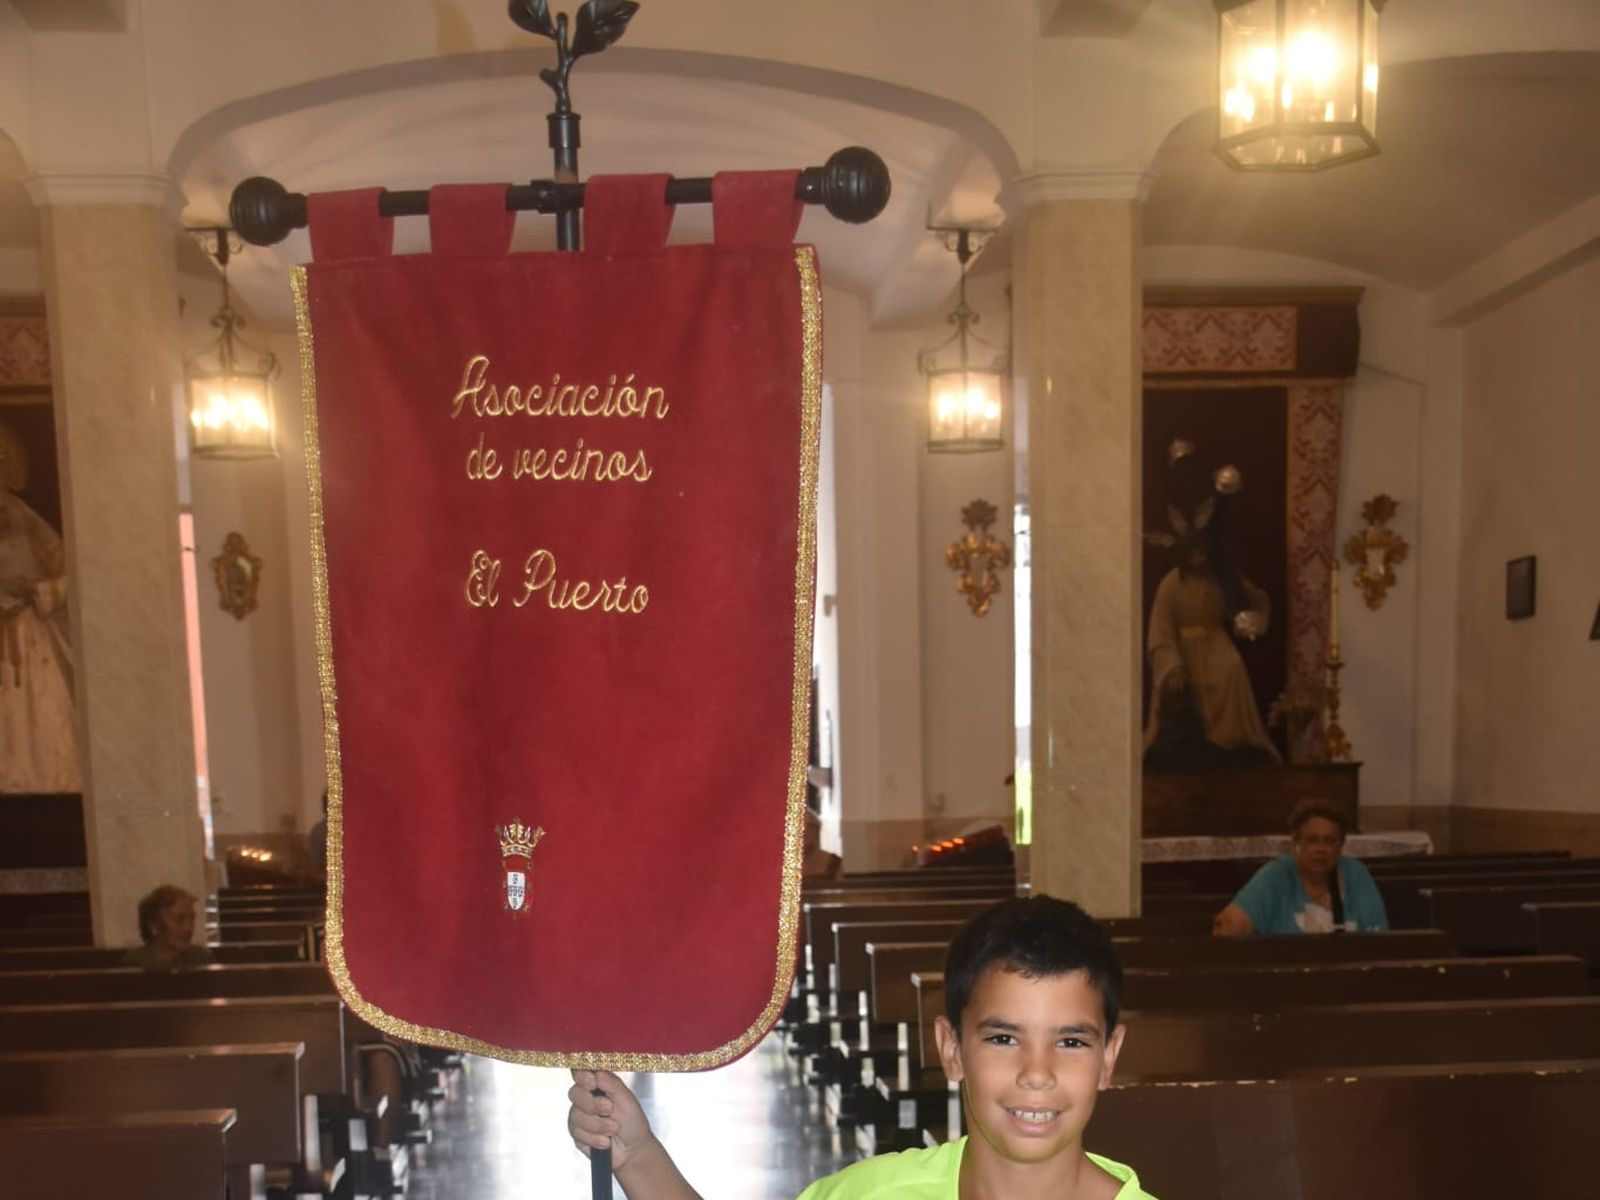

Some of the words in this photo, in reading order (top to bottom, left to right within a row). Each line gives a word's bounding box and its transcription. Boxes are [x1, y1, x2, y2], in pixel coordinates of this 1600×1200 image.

[451, 354, 669, 419] Asociación
[466, 432, 503, 480] de
[513, 438, 652, 482] vecinos
[464, 550, 500, 607] El
[513, 549, 649, 613] Puerto
